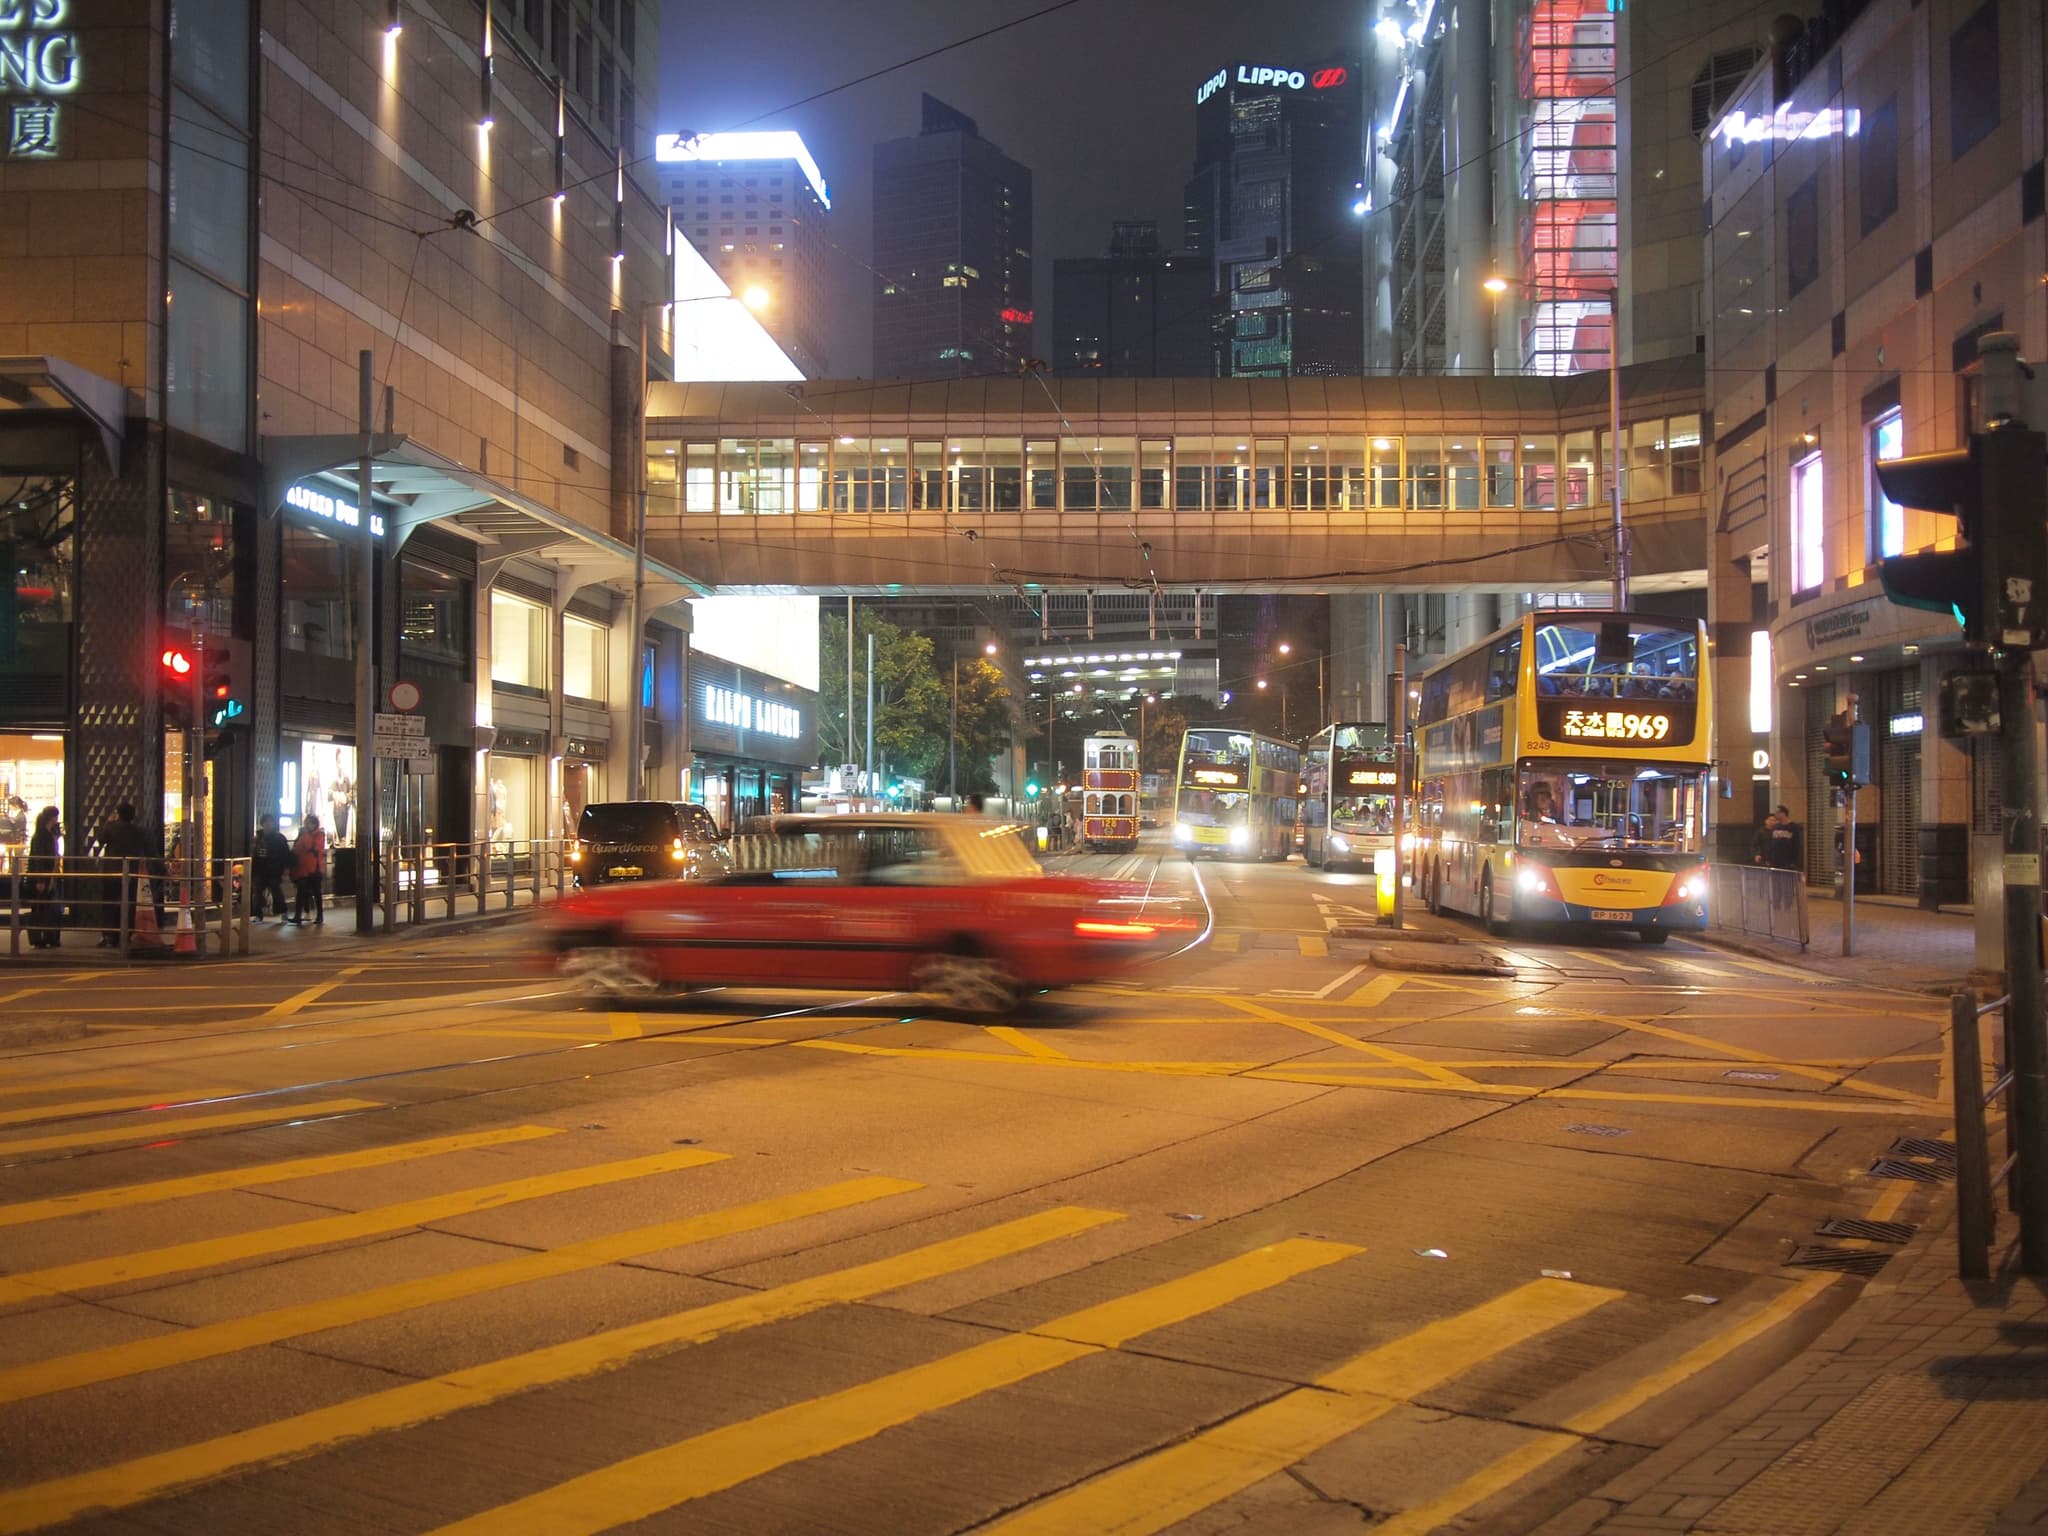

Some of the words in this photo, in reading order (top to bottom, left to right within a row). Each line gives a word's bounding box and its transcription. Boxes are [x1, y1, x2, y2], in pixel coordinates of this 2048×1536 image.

[1197, 69, 1227, 105] LIPPO
[1238, 65, 1305, 90] LIPPO
[9, 100, 59, 158] 廈
[335, 498, 385, 537] DUNLL
[705, 685, 751, 730] RALPH
[1623, 714, 1669, 740] 969
[417, 749, 428, 757] 12
[1527, 741, 1551, 751] 8249
[592, 842, 659, 854] Guardforce
